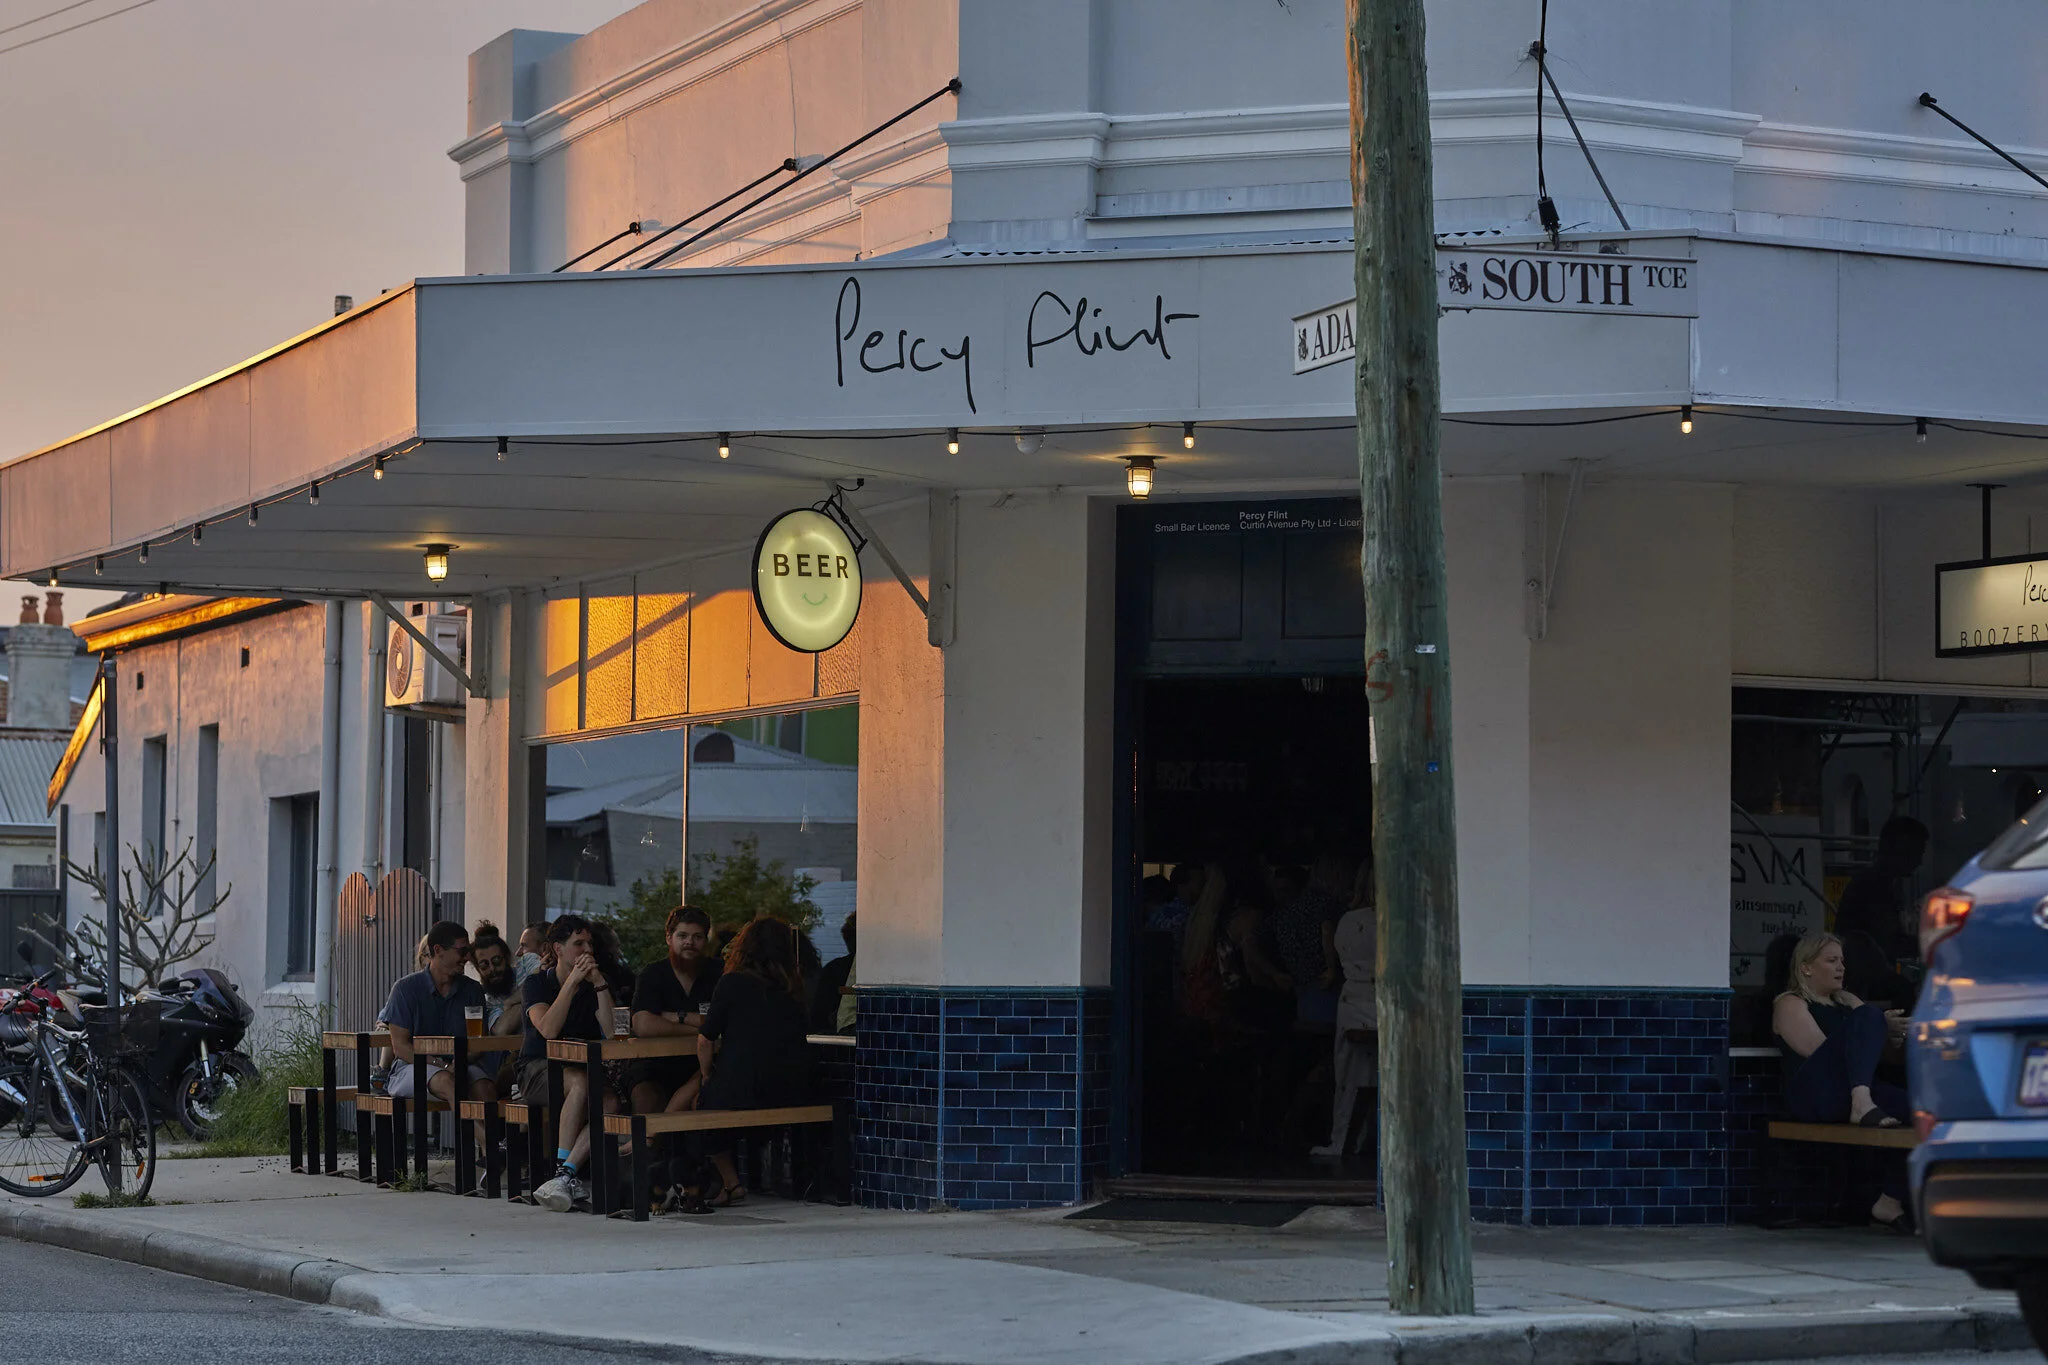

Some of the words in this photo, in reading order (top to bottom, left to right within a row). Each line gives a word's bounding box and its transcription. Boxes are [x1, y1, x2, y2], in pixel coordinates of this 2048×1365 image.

[1482, 257, 1634, 306] SOUTH
[1643, 264, 1688, 289] TCE
[836, 276, 977, 415] Percy
[1027, 290, 1200, 369] Flint
[1239, 511, 1265, 521] Percy
[1267, 510, 1288, 520] Flint
[1239, 520, 1266, 530] Curtin
[1266, 520, 1299, 529] Avenue
[1301, 519, 1316, 530] Pty
[1317, 519, 1331, 528] Ltd
[1155, 523, 1179, 533] Small
[1180, 523, 1196, 532] Bar
[1197, 523, 1231, 532] Licence
[773, 553, 849, 579] BEER
